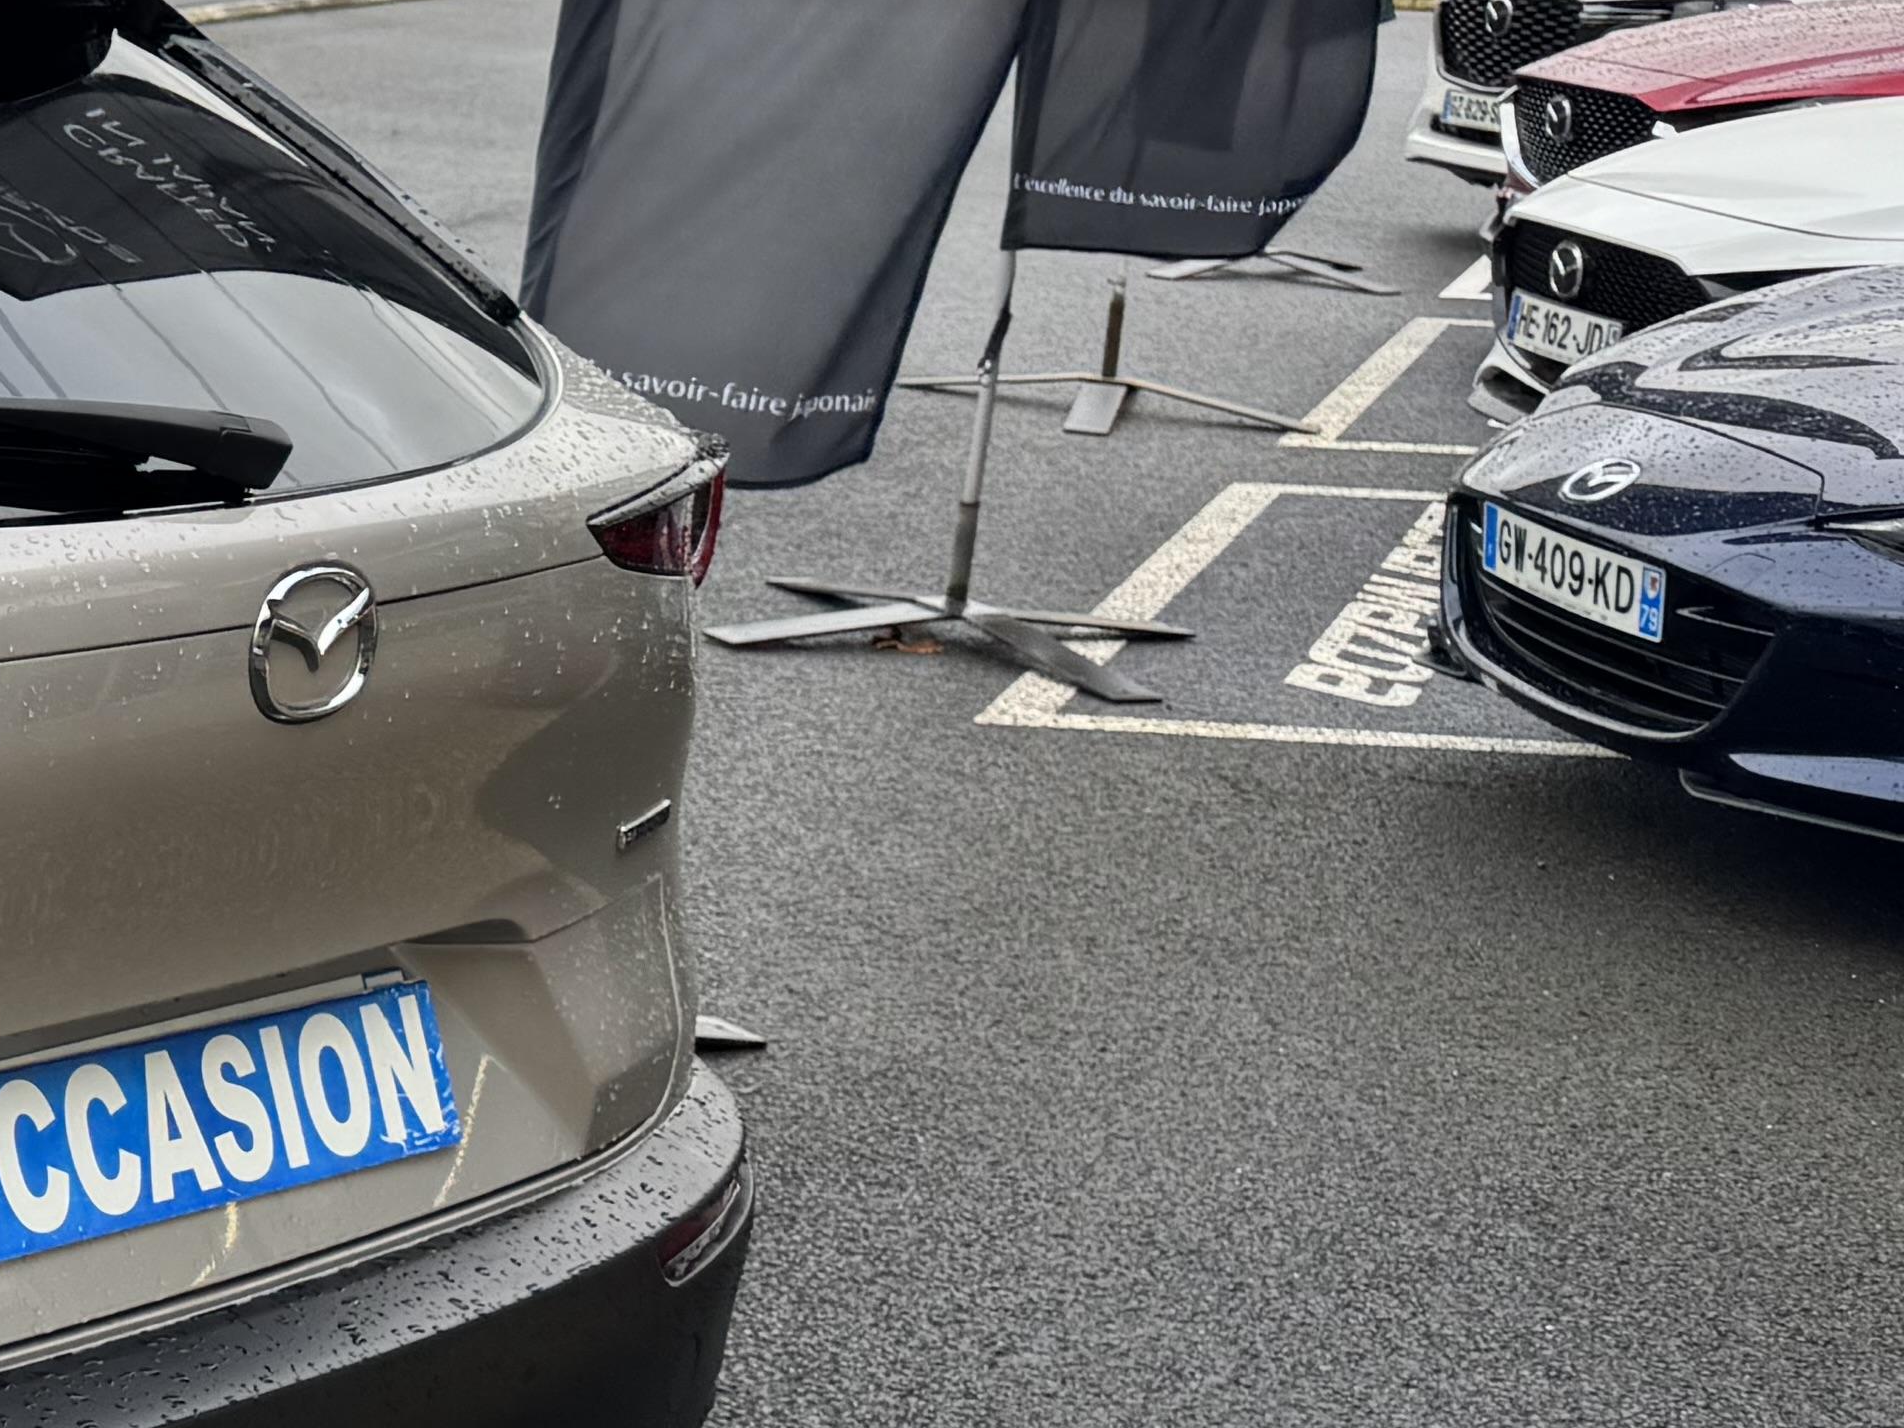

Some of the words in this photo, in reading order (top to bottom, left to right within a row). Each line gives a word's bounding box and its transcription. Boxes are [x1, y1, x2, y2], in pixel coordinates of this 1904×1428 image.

[1109, 186, 1135, 205] du
[622, 371, 788, 416] savoir-faire
[1498, 519, 1635, 615] GW-409-KD
[1641, 604, 1660, 633] 79
